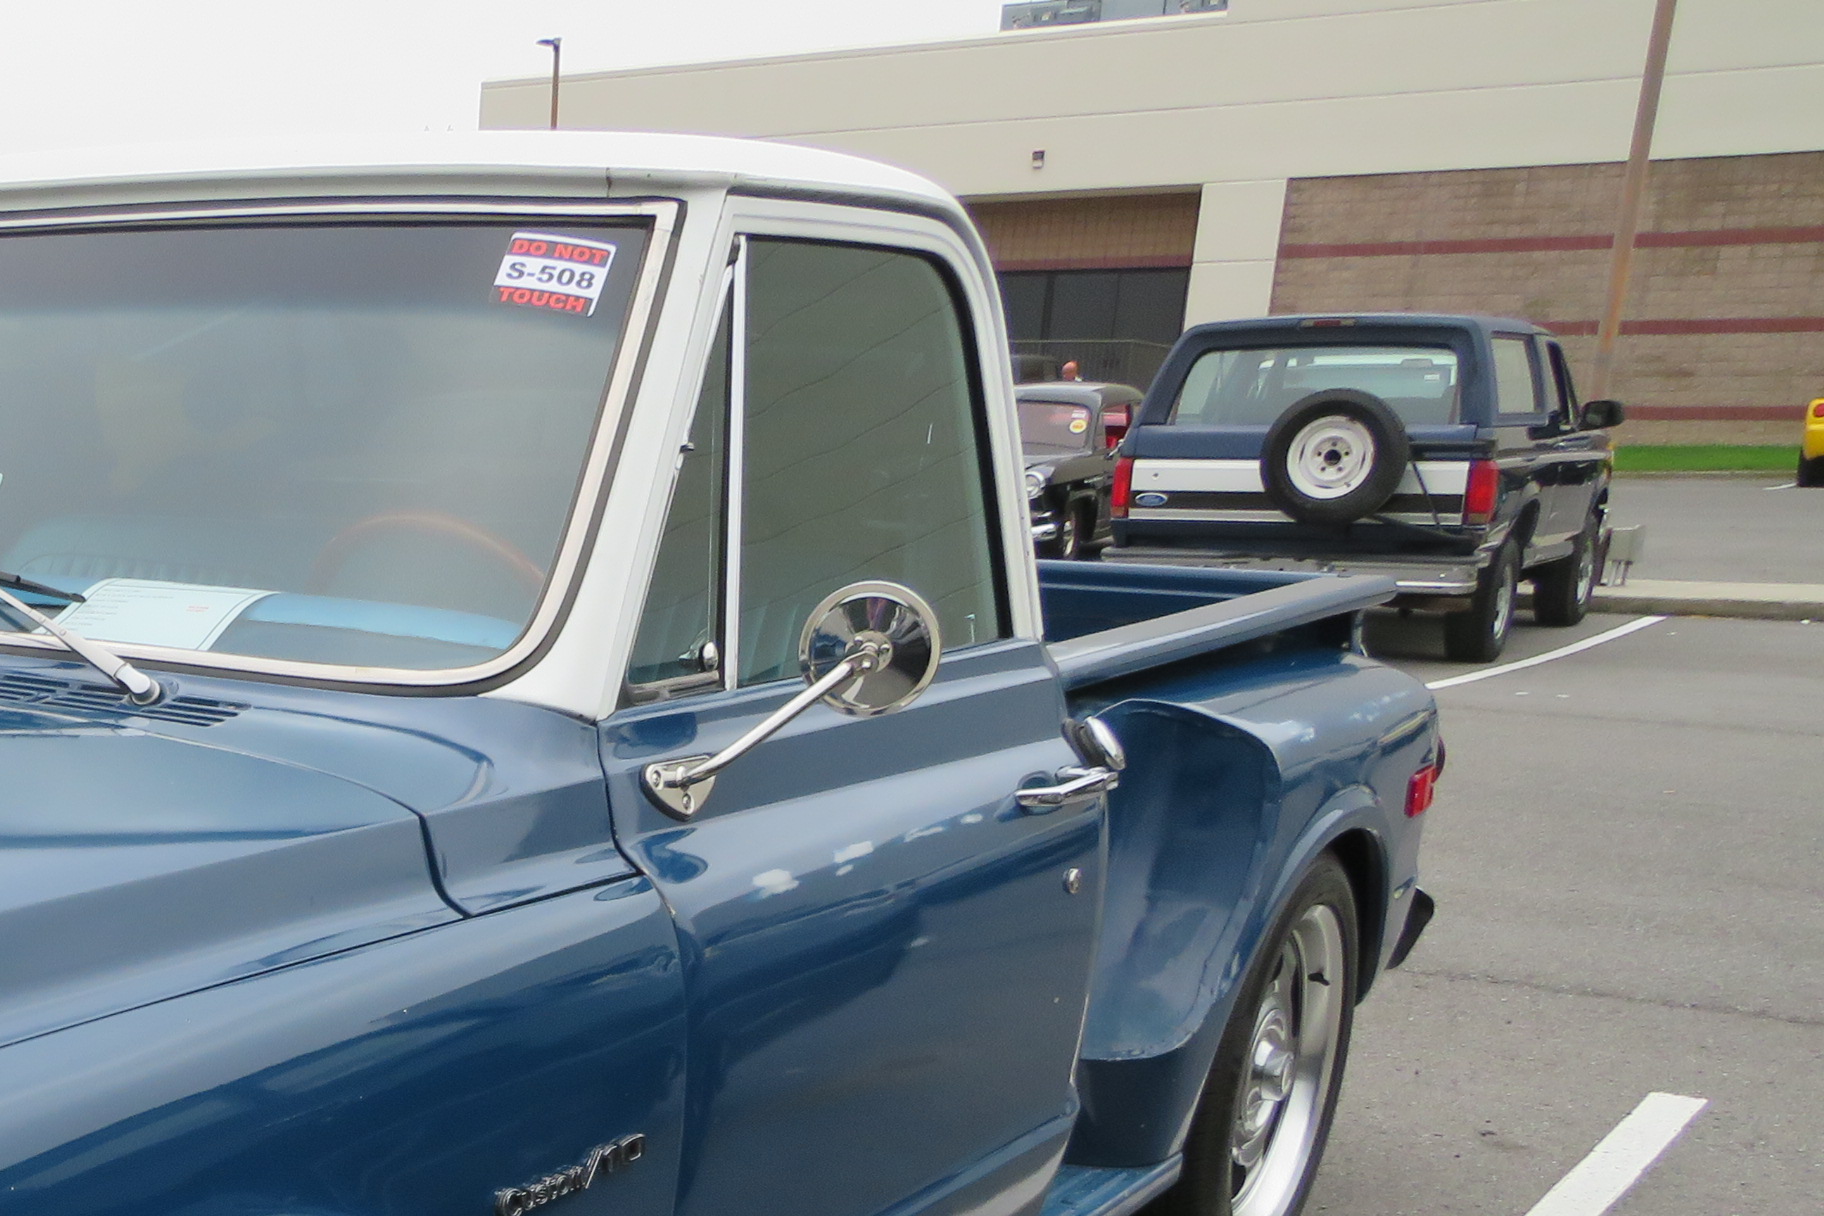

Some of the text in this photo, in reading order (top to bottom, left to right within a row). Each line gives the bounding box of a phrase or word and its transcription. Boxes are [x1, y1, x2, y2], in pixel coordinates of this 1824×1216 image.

[512, 240, 609, 265] DO NOT
[505, 261, 595, 290] S-508
[499, 287, 587, 312] TOUCH
